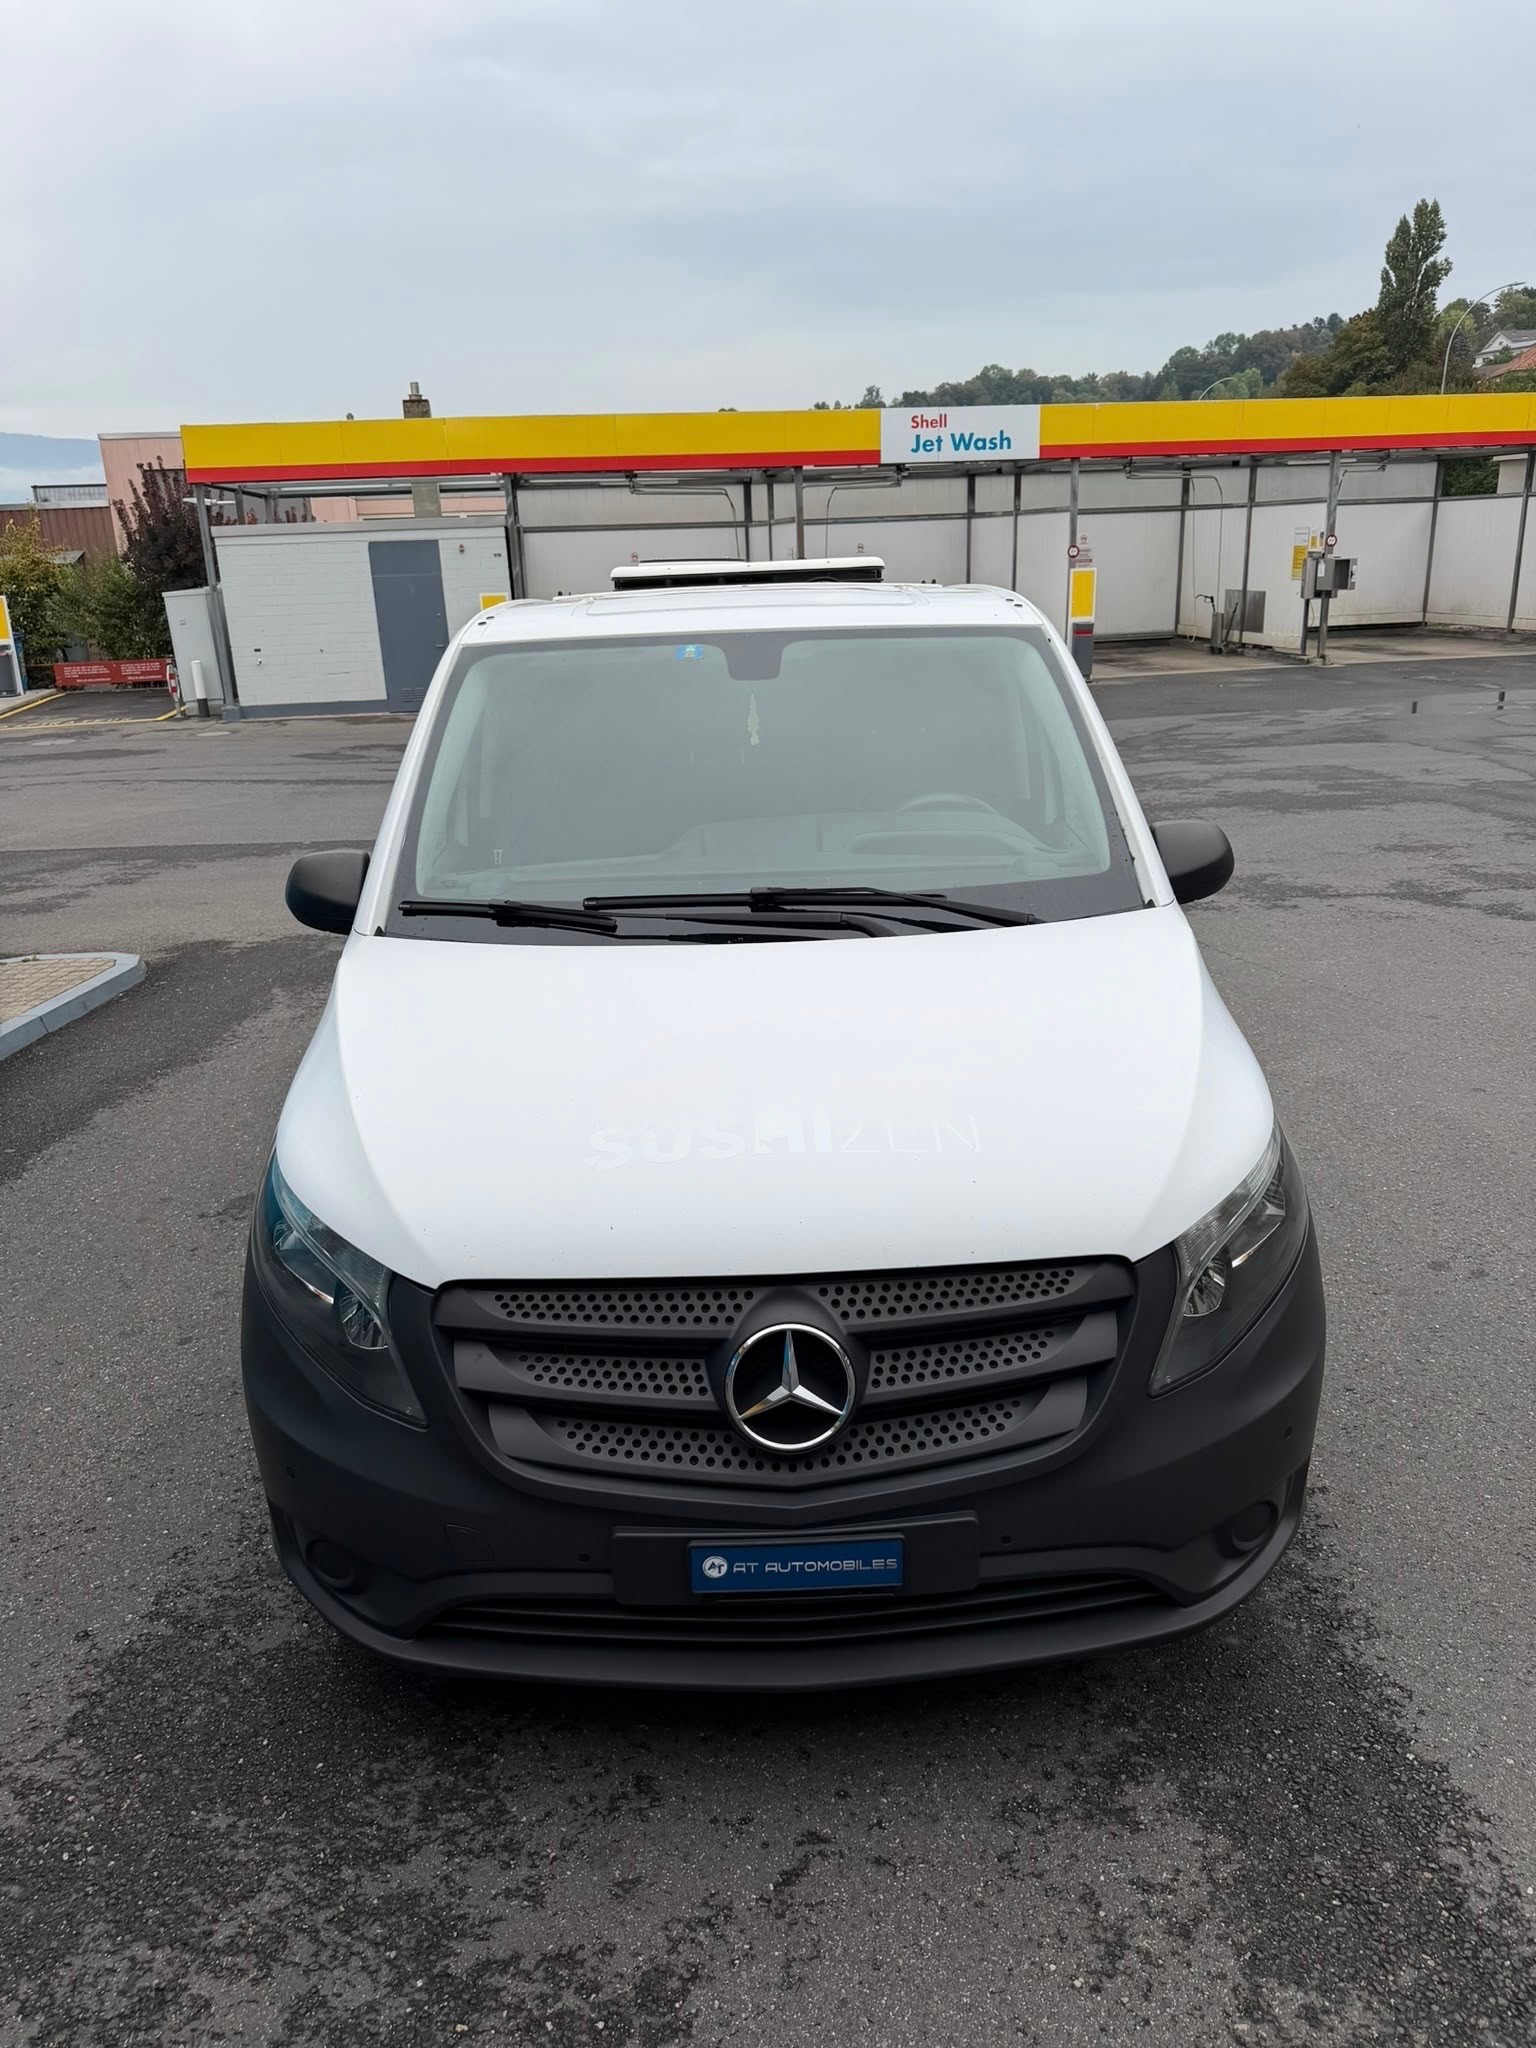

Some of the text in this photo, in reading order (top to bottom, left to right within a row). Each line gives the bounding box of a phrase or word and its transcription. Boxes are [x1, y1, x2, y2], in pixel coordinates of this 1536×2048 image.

[911, 413, 948, 429] Shell
[910, 429, 1012, 453] Jet Wash
[732, 1558, 898, 1574] AT AUTOMOBILES
